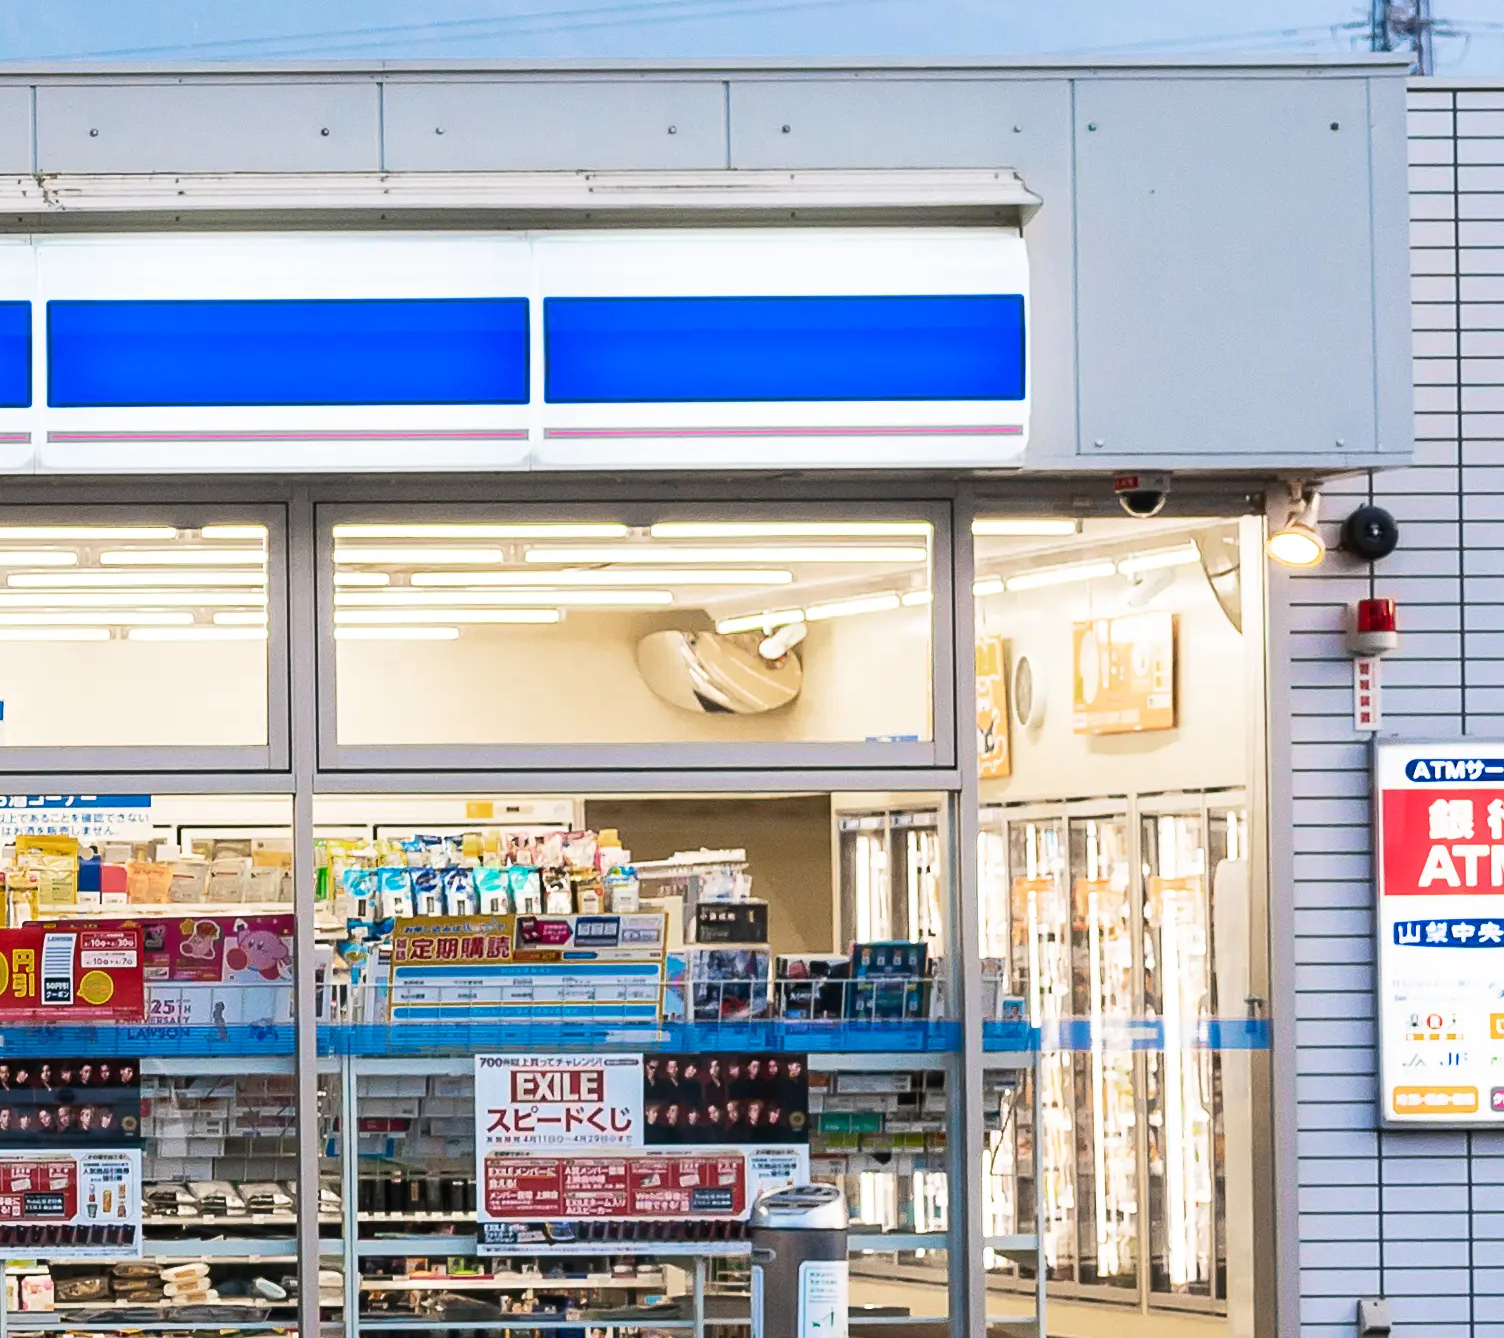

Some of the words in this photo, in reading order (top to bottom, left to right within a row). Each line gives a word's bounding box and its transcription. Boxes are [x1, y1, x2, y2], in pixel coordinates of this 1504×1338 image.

[409, 936, 511, 961] 定期購読
[516, 1072, 598, 1101] EXILE
[486, 1105, 633, 1133] スピードくじ
